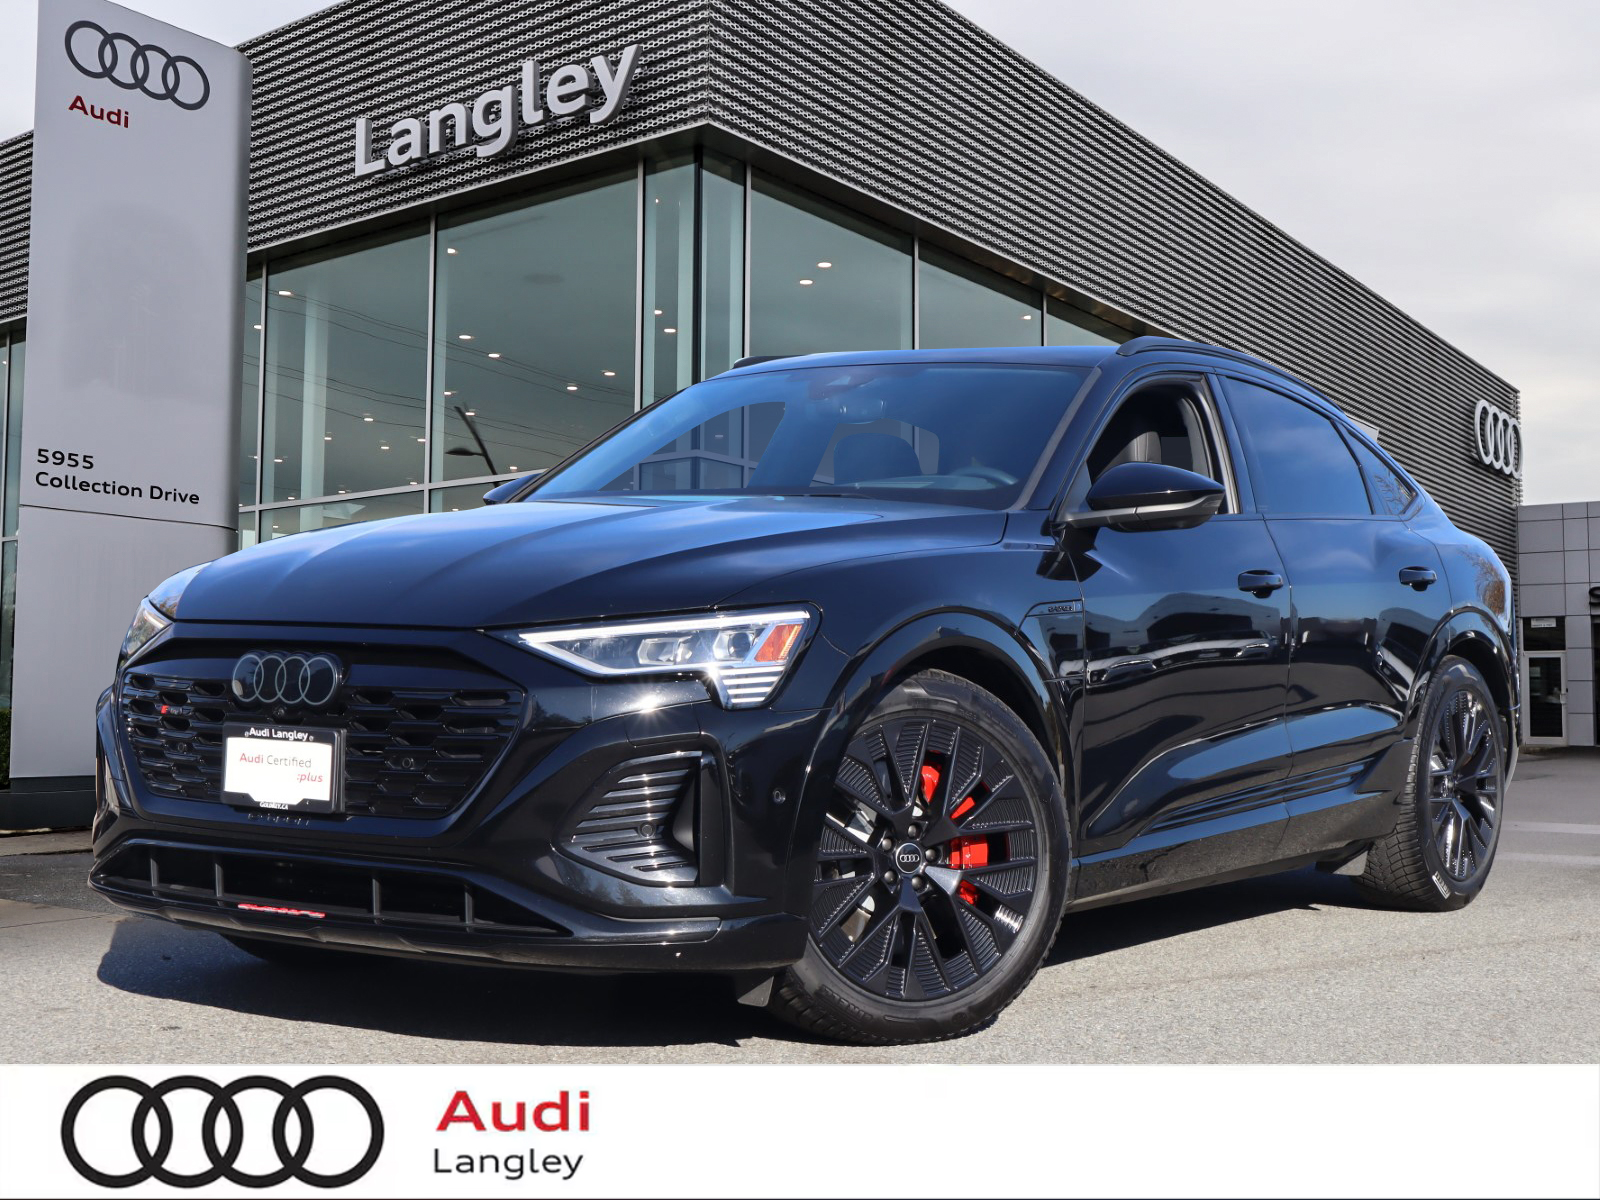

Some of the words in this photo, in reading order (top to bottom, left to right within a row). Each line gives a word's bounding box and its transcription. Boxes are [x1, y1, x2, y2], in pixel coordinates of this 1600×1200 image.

[68, 95, 129, 128] Audi
[354, 44, 643, 177] Langley
[37, 448, 94, 469] 5955
[35, 471, 143, 498] Collection
[149, 485, 200, 505] Drive
[249, 727, 270, 737] Audi
[271, 729, 309, 742] Langley
[239, 752, 264, 764] Audi
[266, 754, 312, 768] Certified
